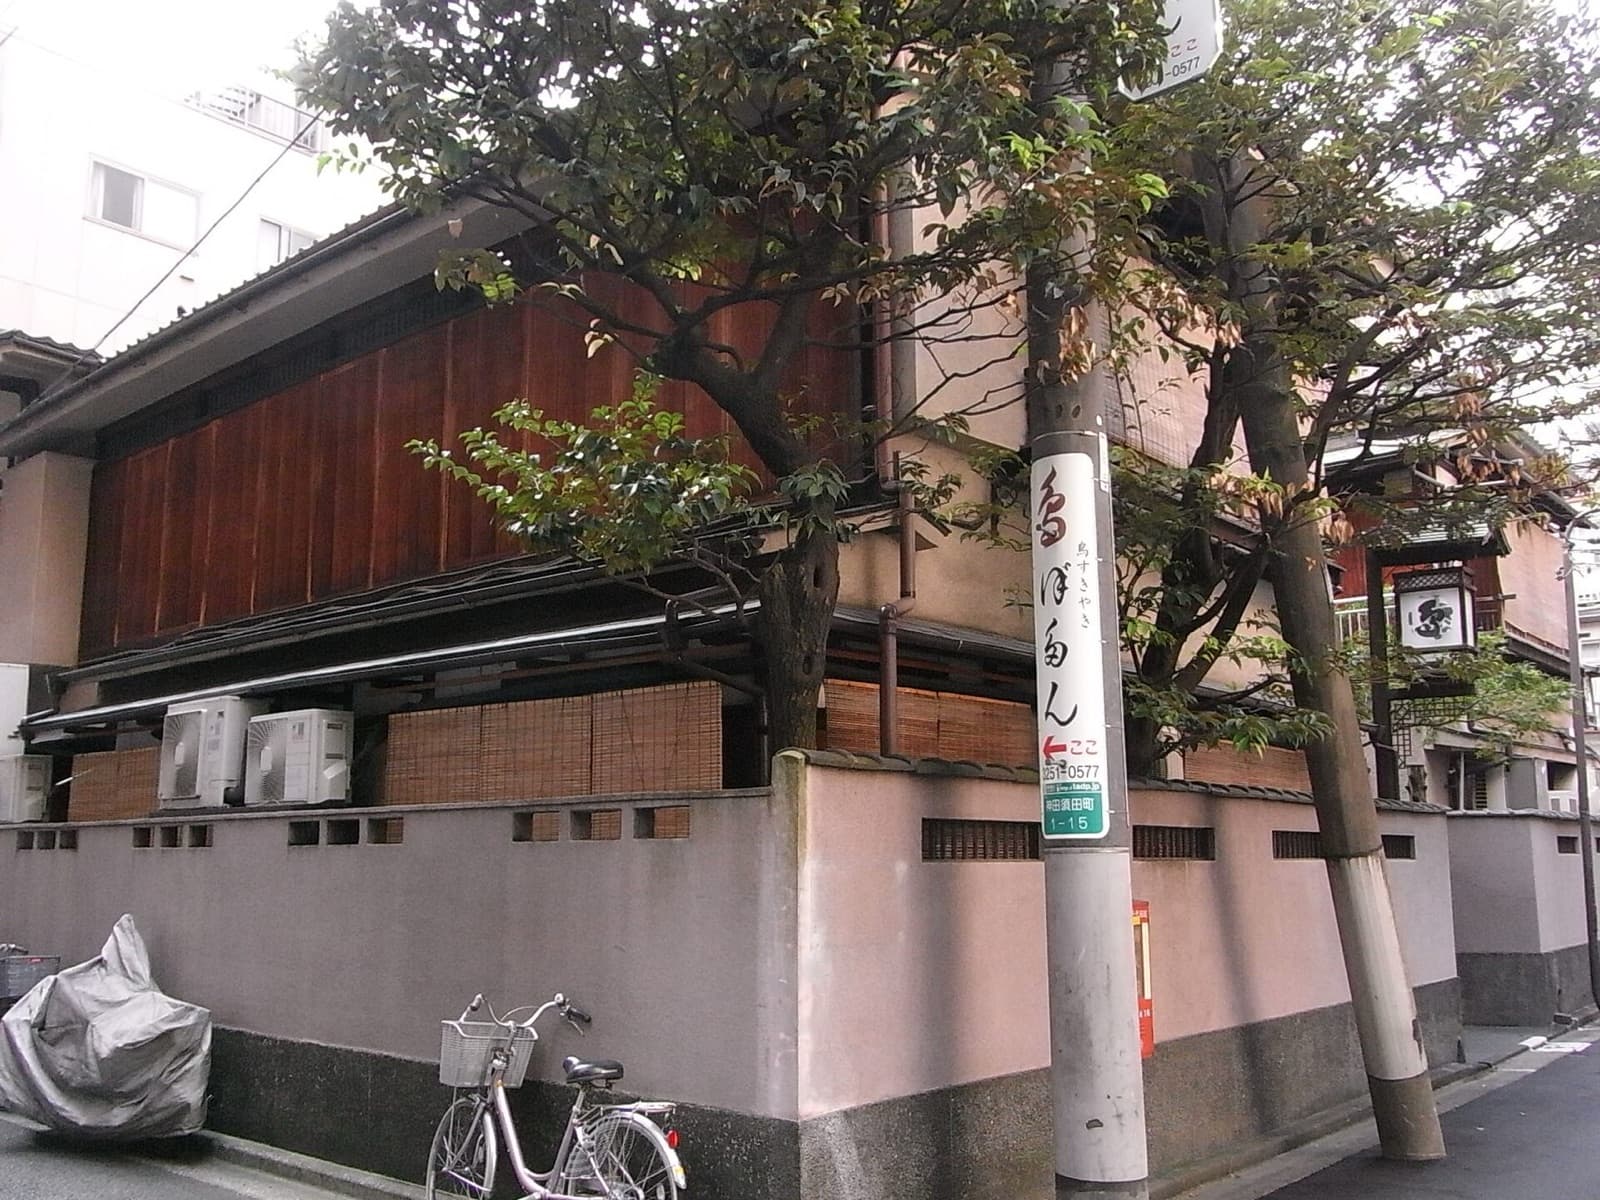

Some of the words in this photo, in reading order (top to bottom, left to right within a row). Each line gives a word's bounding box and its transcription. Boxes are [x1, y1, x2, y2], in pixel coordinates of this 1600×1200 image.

[1170, 38, 1198, 58] ここ
[1076, 541, 1092, 629] 鳥すきやき
[1070, 739, 1099, 756] ここ
[1050, 816, 1089, 830] 1-15
